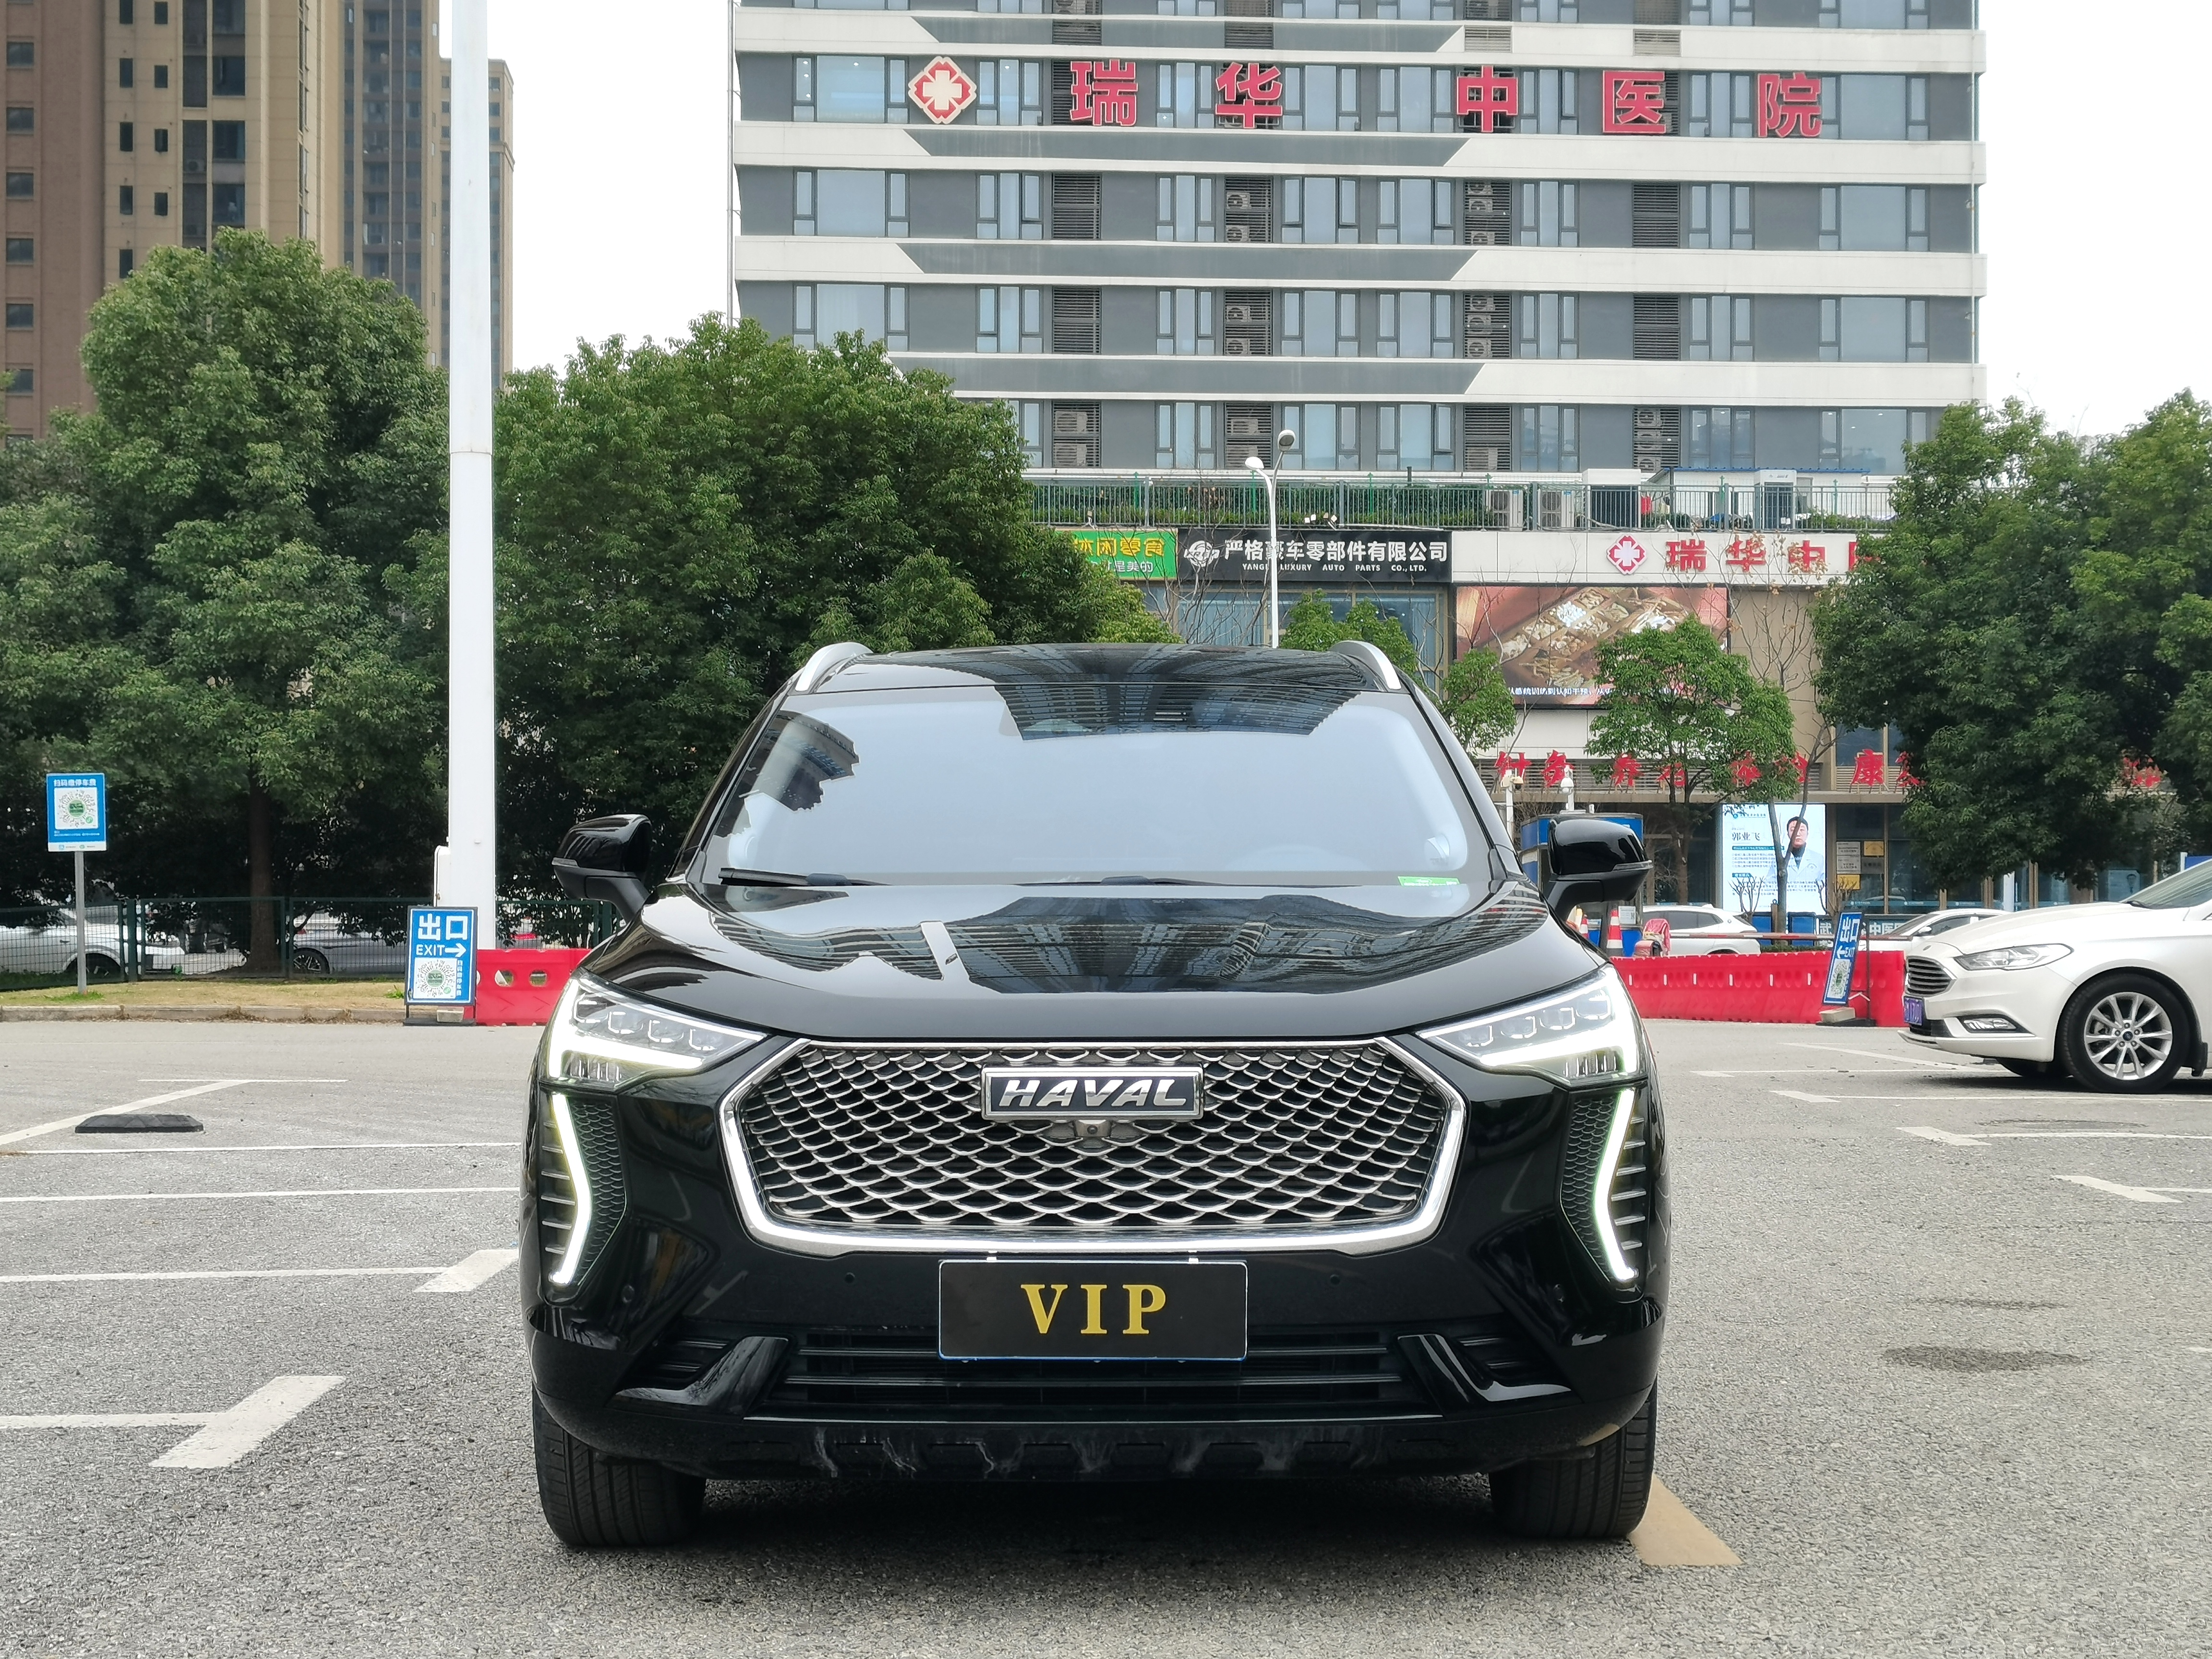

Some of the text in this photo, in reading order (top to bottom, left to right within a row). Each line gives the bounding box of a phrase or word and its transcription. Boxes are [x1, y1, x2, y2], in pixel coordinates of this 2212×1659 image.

[1069, 59, 1824, 139] 瑞华中医院
[1225, 539, 1447, 562] 严格豪车零部件有限公司
[1666, 533, 1881, 574] 瑞华中
[418, 913, 468, 941] 出口
[1839, 916, 1860, 943] 出口
[416, 944, 445, 956] EXIT
[998, 1079, 1187, 1107] HAVAL
[1021, 1284, 1166, 1334] VIP
